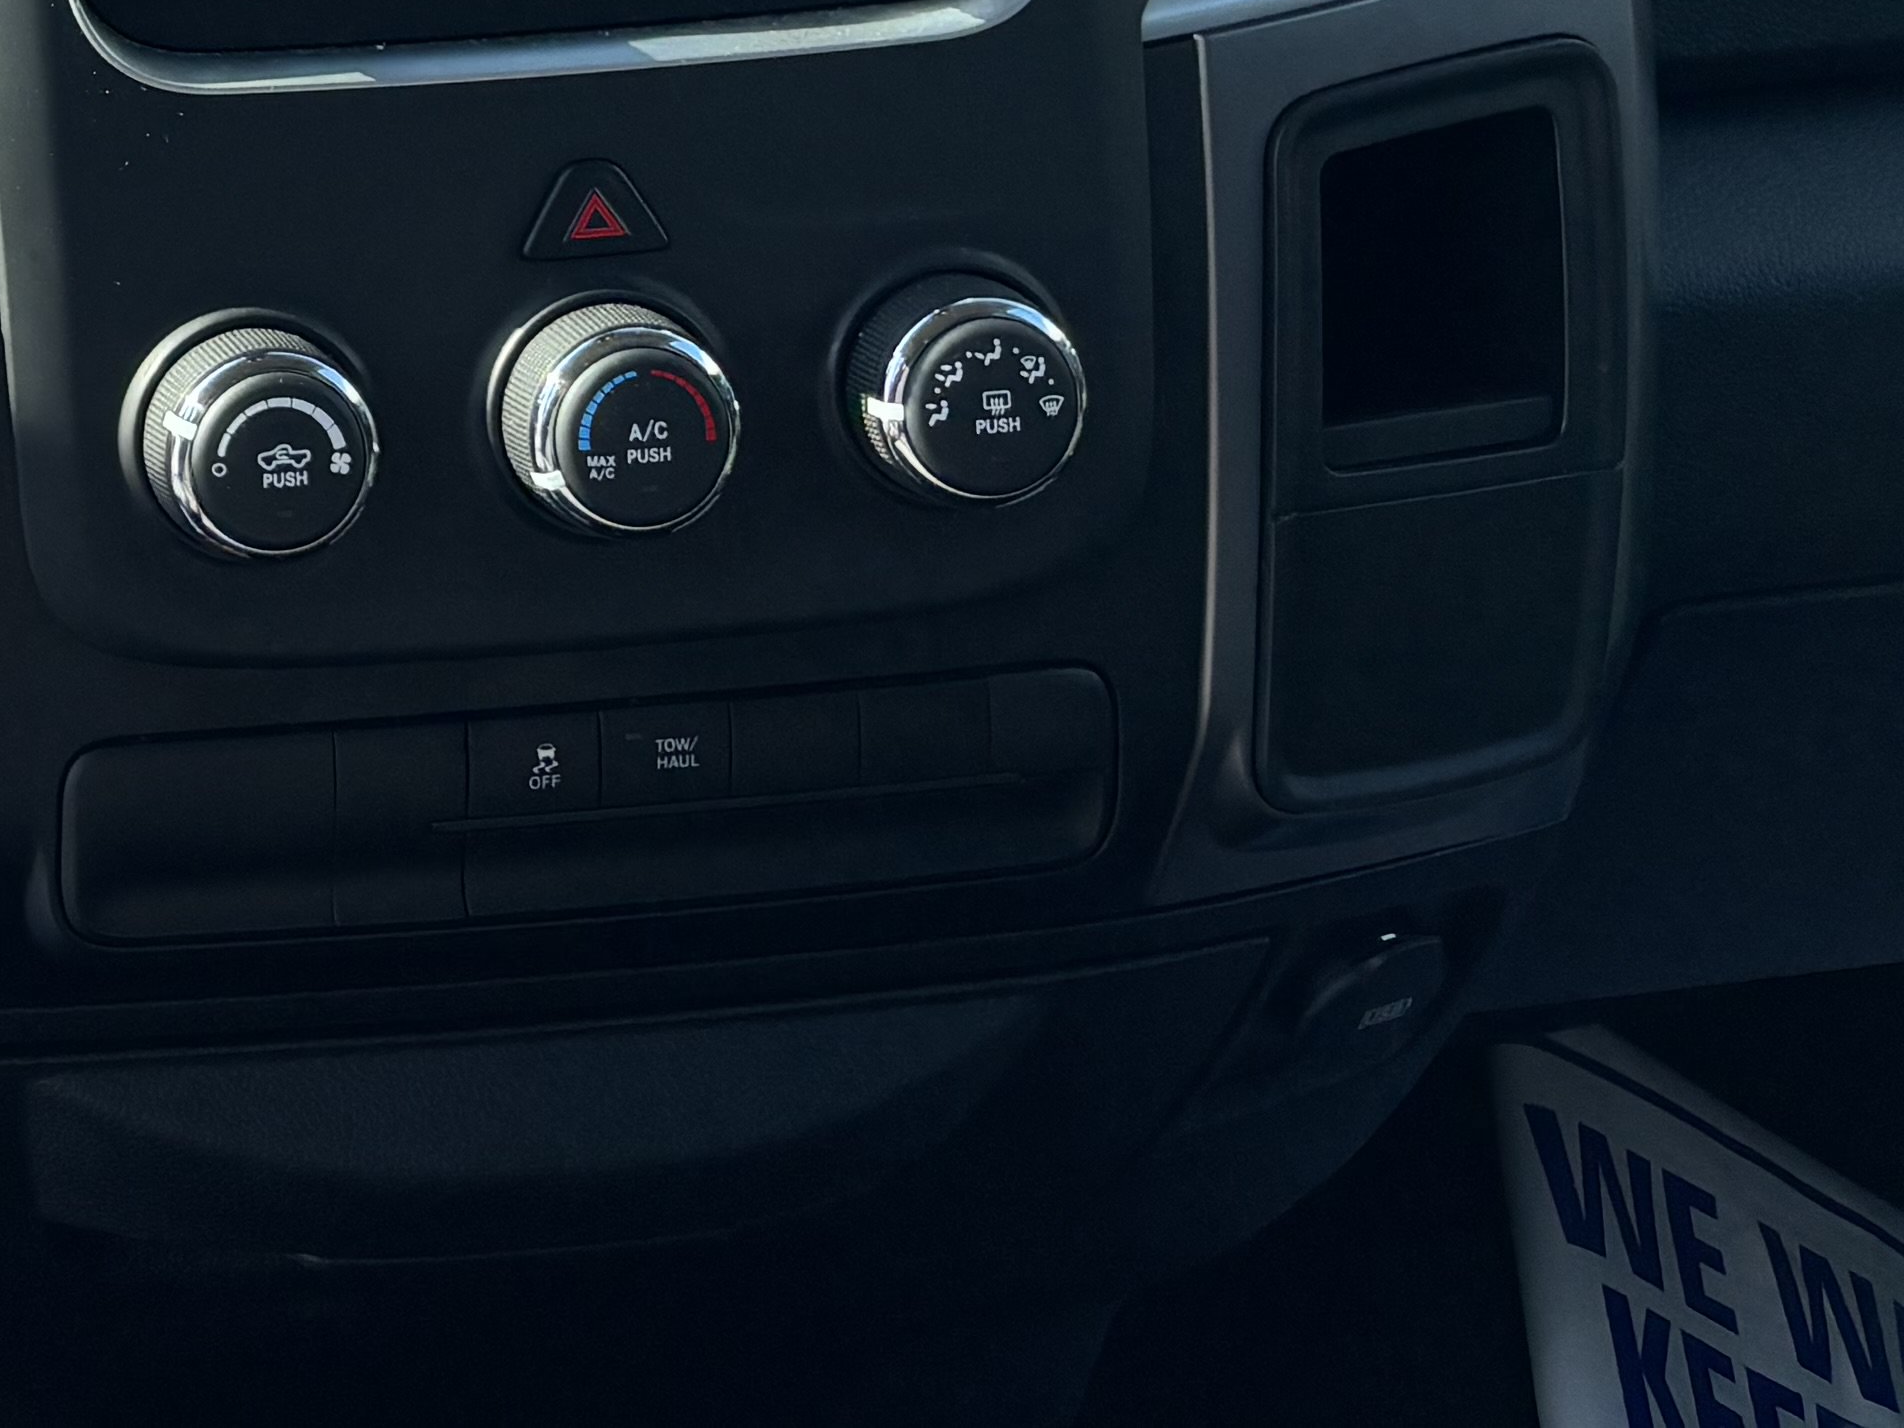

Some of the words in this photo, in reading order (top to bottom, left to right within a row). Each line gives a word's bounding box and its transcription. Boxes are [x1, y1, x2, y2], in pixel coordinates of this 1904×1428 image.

[629, 419, 668, 442] A/C
[975, 416, 1021, 434] PUSH
[587, 455, 616, 467] MAX
[627, 446, 671, 464] PUSH
[262, 470, 308, 489] PUSH
[589, 467, 616, 481] A/C
[655, 735, 699, 753] TOW/
[657, 753, 700, 770] HAUL
[528, 773, 561, 790] OFF
[1523, 1102, 1739, 1336] WE
